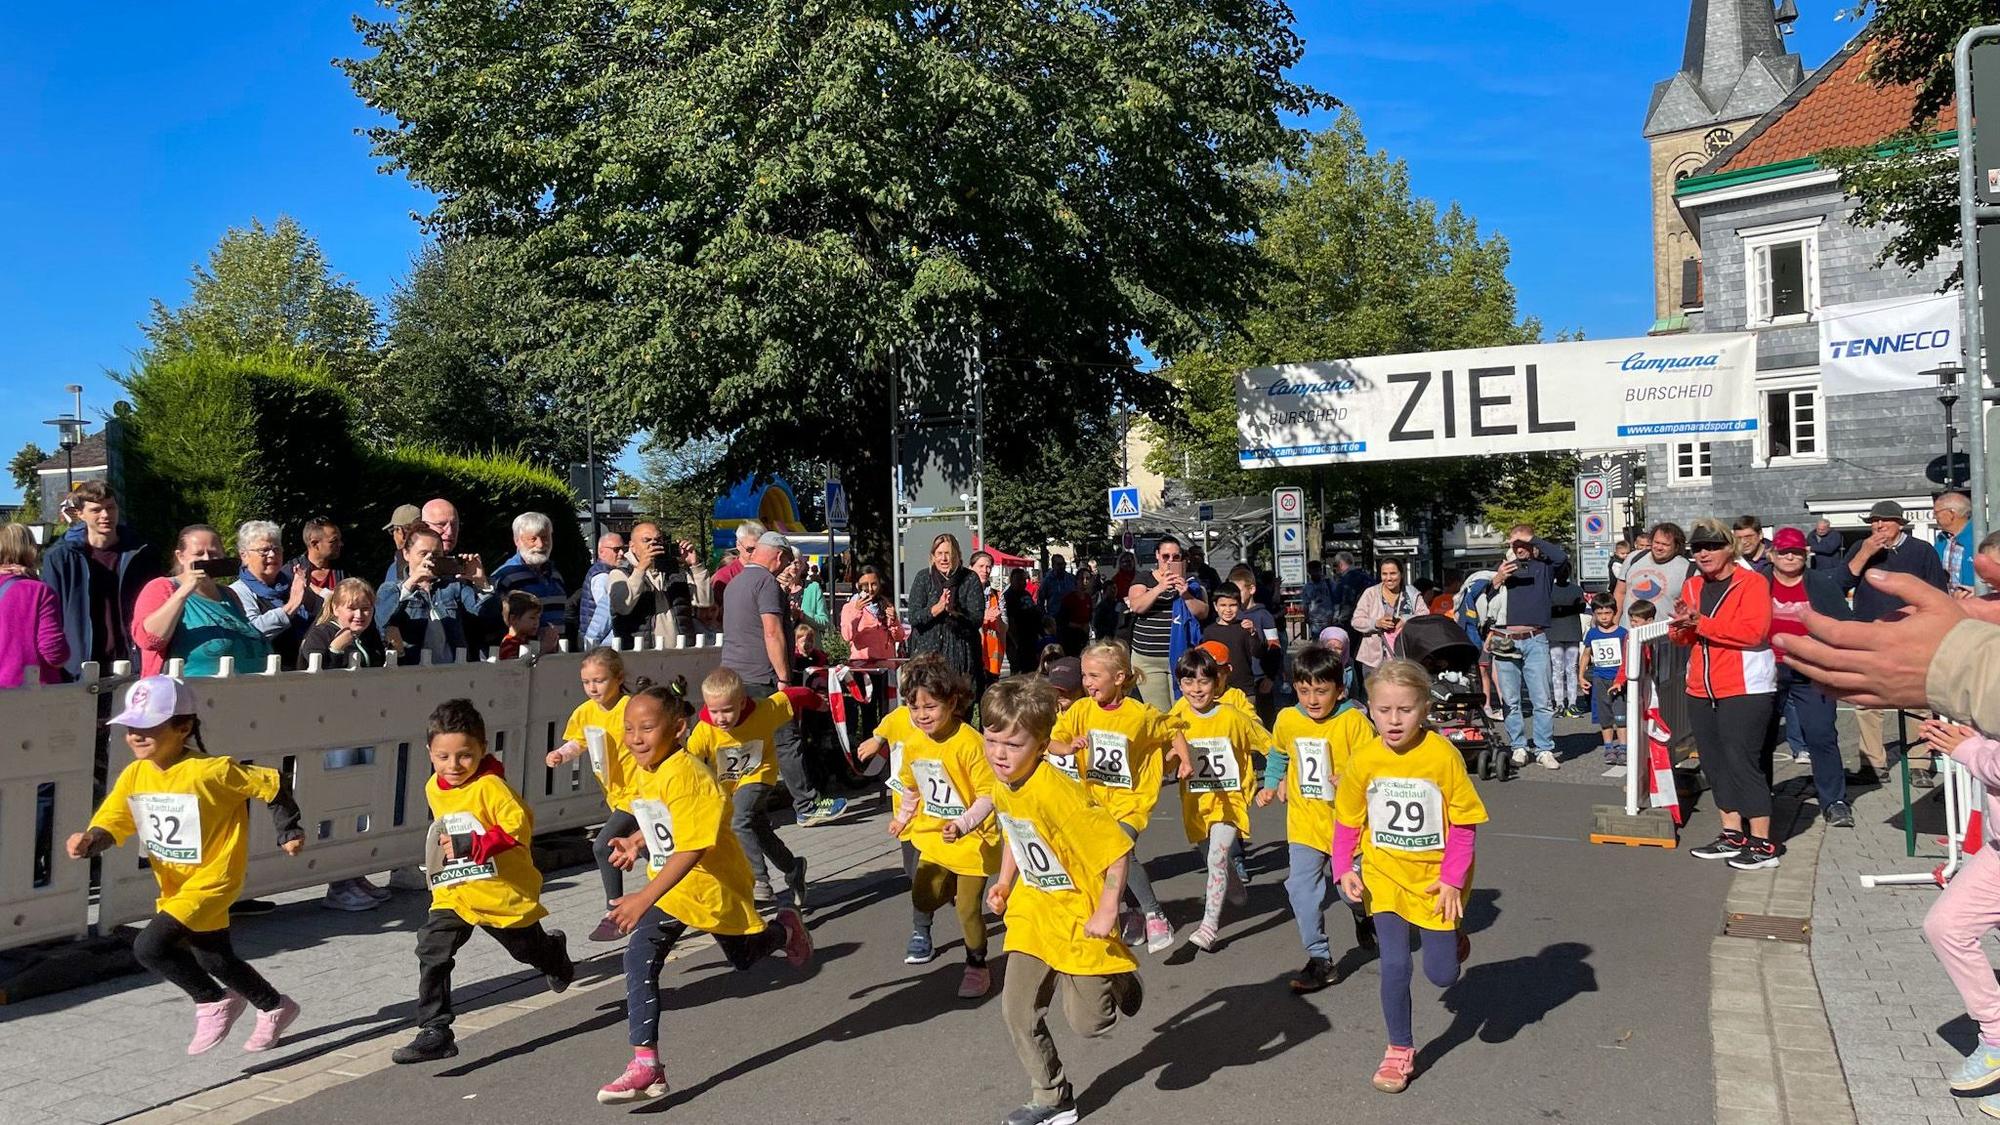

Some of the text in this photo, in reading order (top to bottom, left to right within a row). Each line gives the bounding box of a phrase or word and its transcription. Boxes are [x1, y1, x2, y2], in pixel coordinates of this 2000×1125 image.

[1830, 329, 1950, 358] TENNECO
[1621, 352, 1719, 372] Campana
[1267, 378, 1355, 397] Campana
[1625, 384, 1713, 401] BURSCHEID
[1387, 364, 1576, 441] ZIEL
[1269, 407, 1348, 426] BURSCHEID
[1589, 485, 1599, 494] 20
[1284, 498, 1293, 507] 20
[1599, 647, 1614, 660] 39
[1095, 747, 1122, 772] 28
[1197, 755, 1226, 777] 25
[1306, 757, 1320, 782] 2
[1385, 800, 1425, 832] 29
[150, 814, 183, 844] 32
[1020, 842, 1050, 872] 0
